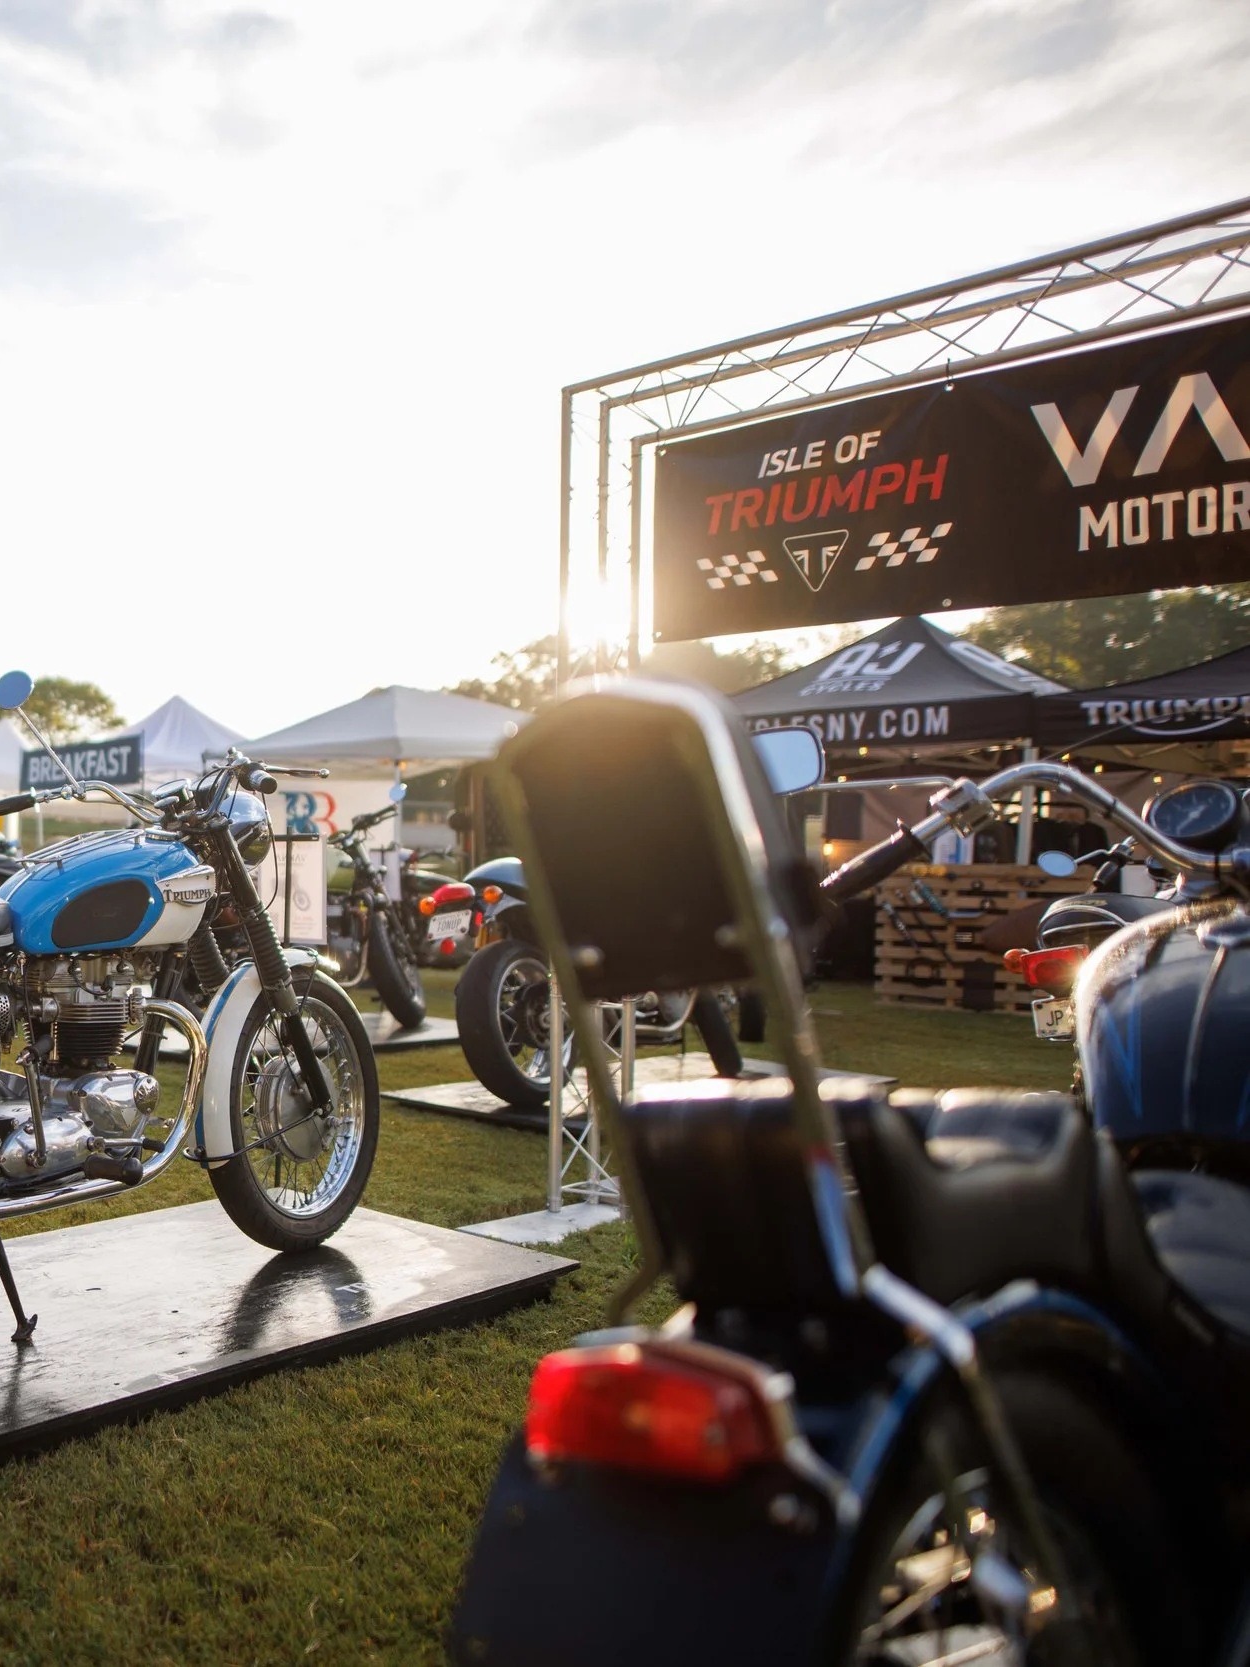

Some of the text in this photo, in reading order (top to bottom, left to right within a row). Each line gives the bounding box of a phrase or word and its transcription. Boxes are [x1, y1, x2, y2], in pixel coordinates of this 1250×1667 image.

[758, 430, 882, 479] ISLE OF
[705, 454, 950, 536] TRIUMPH
[1078, 481, 1250, 552] MOTOR
[799, 678, 888, 697] CYCLES
[27, 745, 132, 784] BREAKFAST
